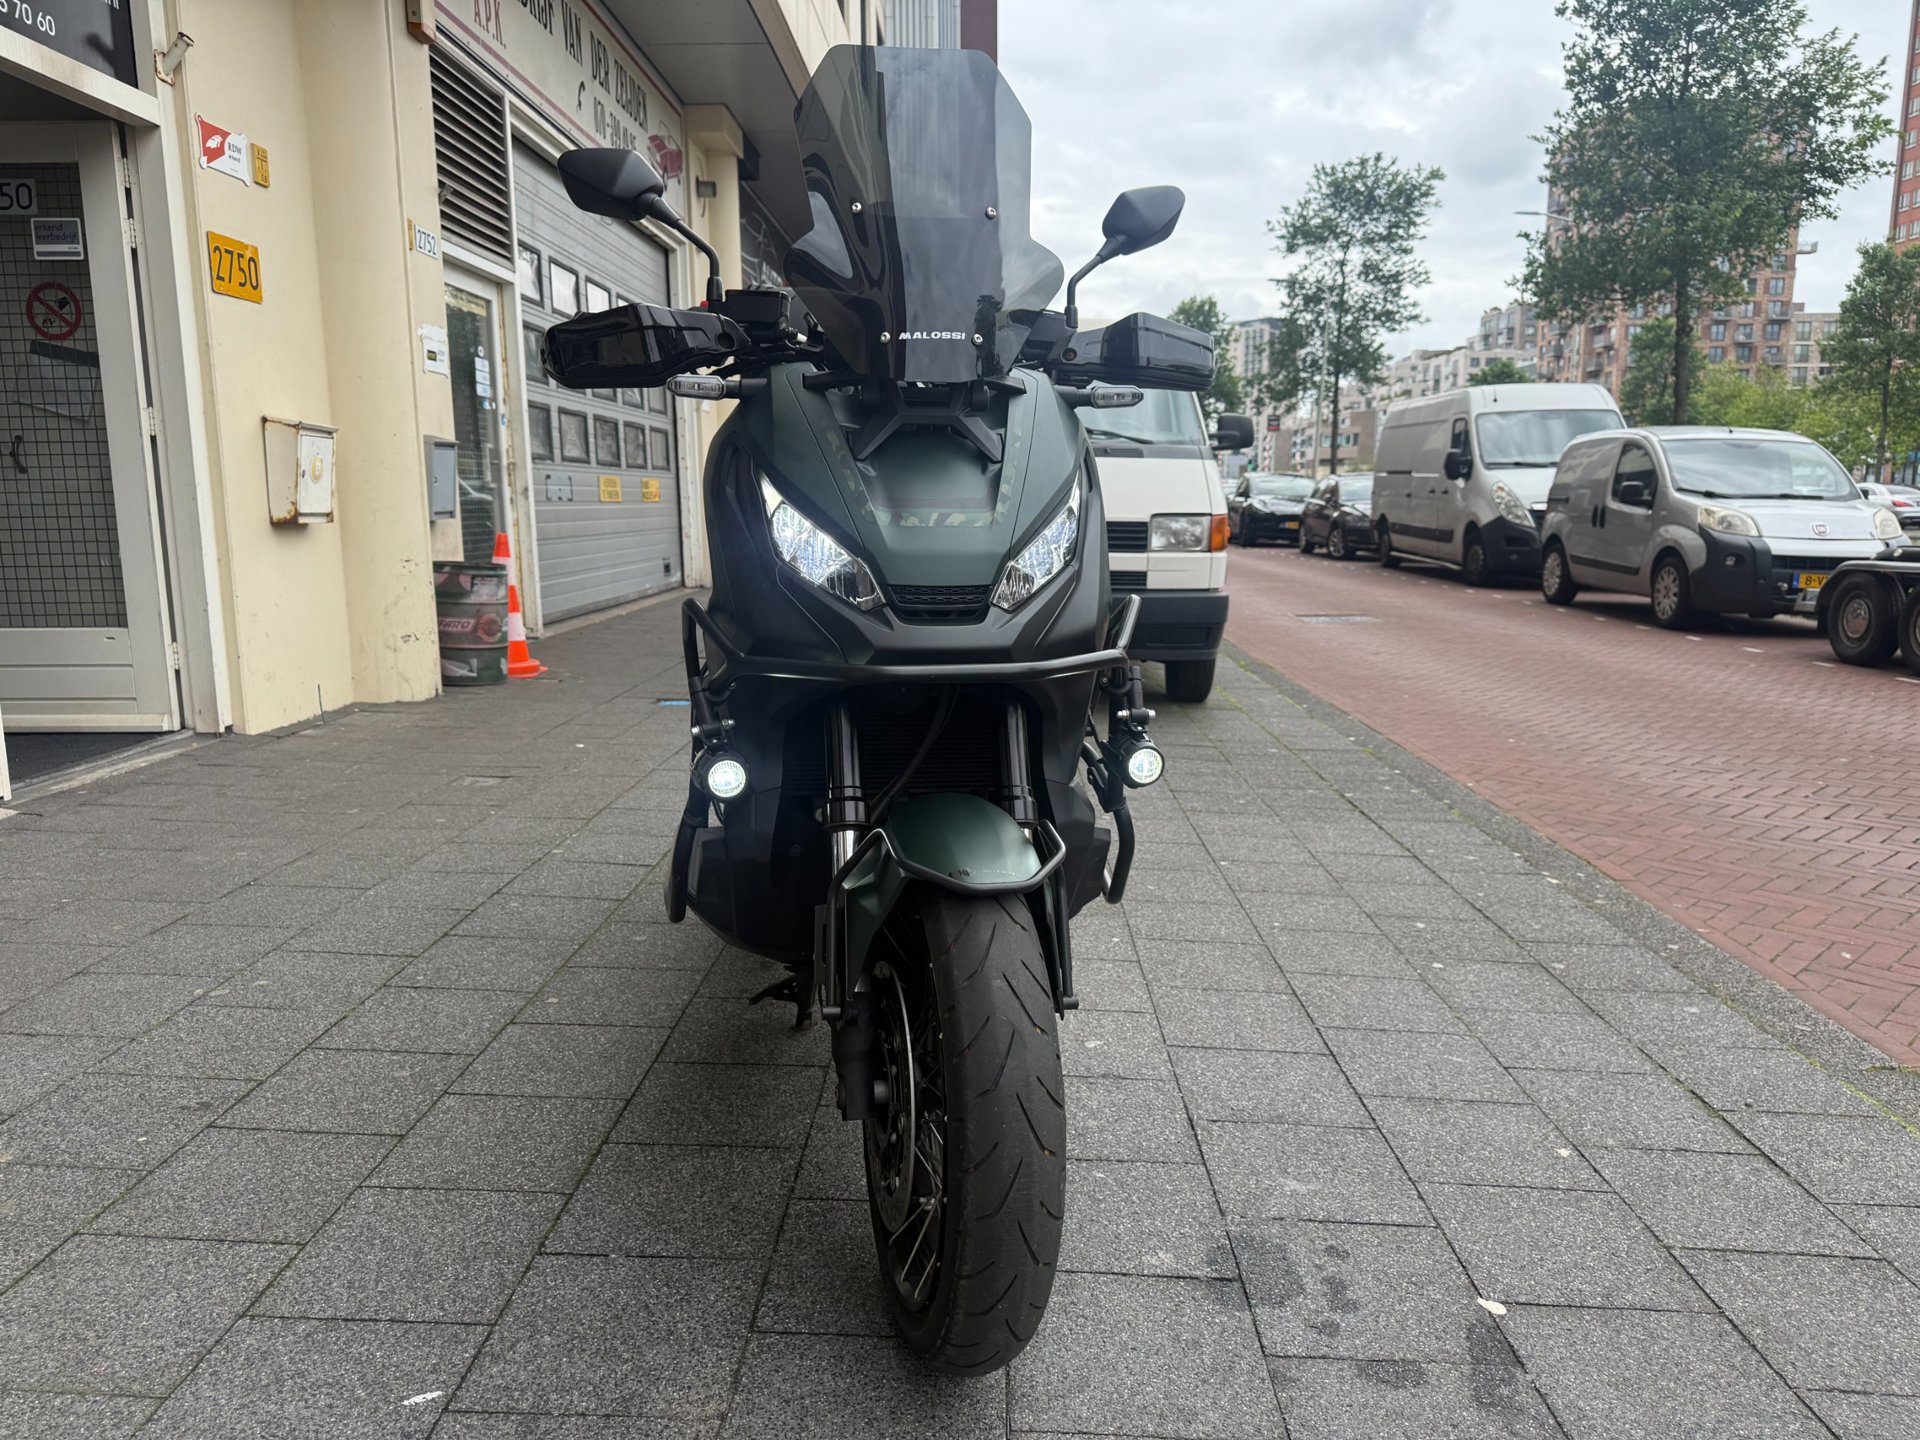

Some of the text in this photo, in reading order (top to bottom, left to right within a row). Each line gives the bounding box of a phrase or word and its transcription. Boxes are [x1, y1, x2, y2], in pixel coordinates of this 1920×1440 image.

[13, 0, 32, 25] 70
[37, 12, 56, 36] 60
[561, 0, 583, 66] VAN
[589, 30, 611, 95] DER
[417, 229, 437, 256] 2752
[213, 244, 259, 291] 2750
[898, 331, 966, 340] MALOSSI
[1804, 575, 1828, 586] 8-V
